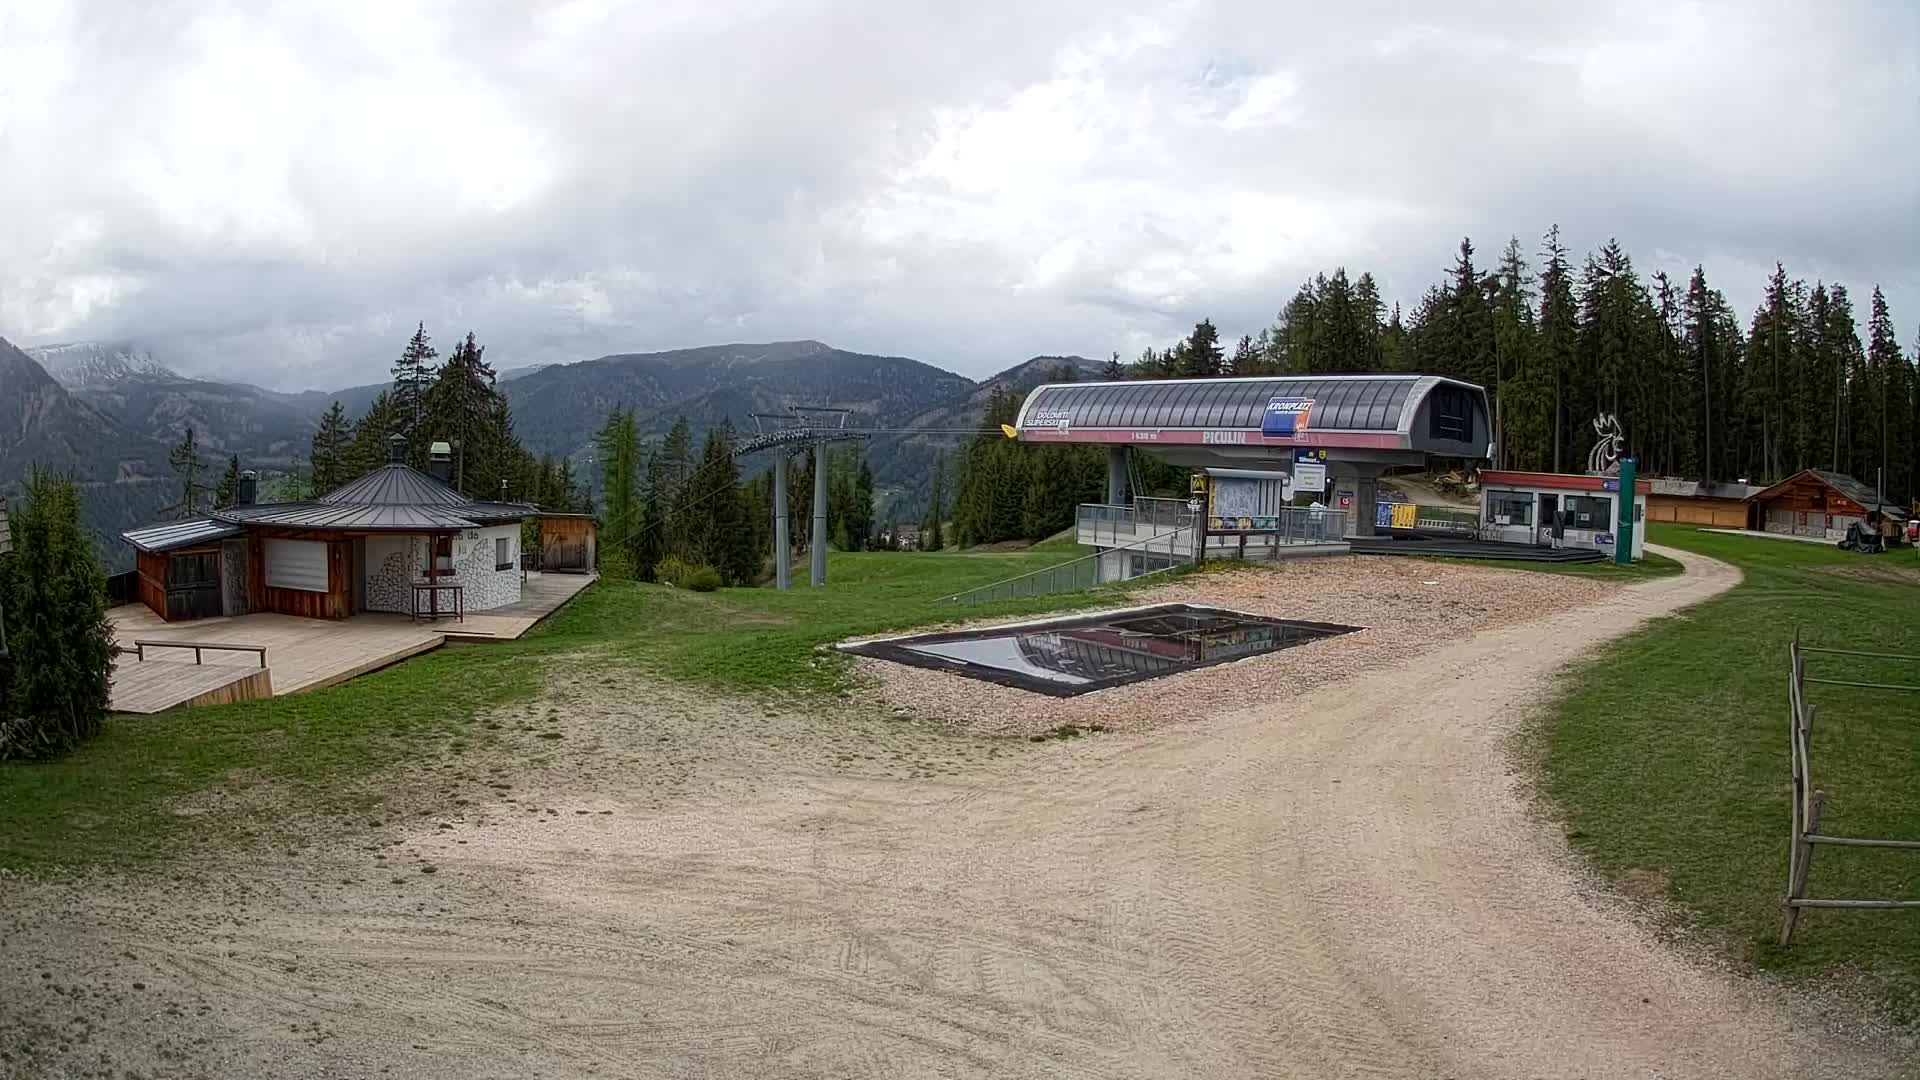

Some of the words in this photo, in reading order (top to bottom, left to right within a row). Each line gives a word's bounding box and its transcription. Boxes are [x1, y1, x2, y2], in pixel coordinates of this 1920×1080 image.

[1267, 402, 1313, 410] KRONPLATZ
[1037, 411, 1069, 419] DOLOMITI
[1202, 431, 1246, 444] PICULIN
